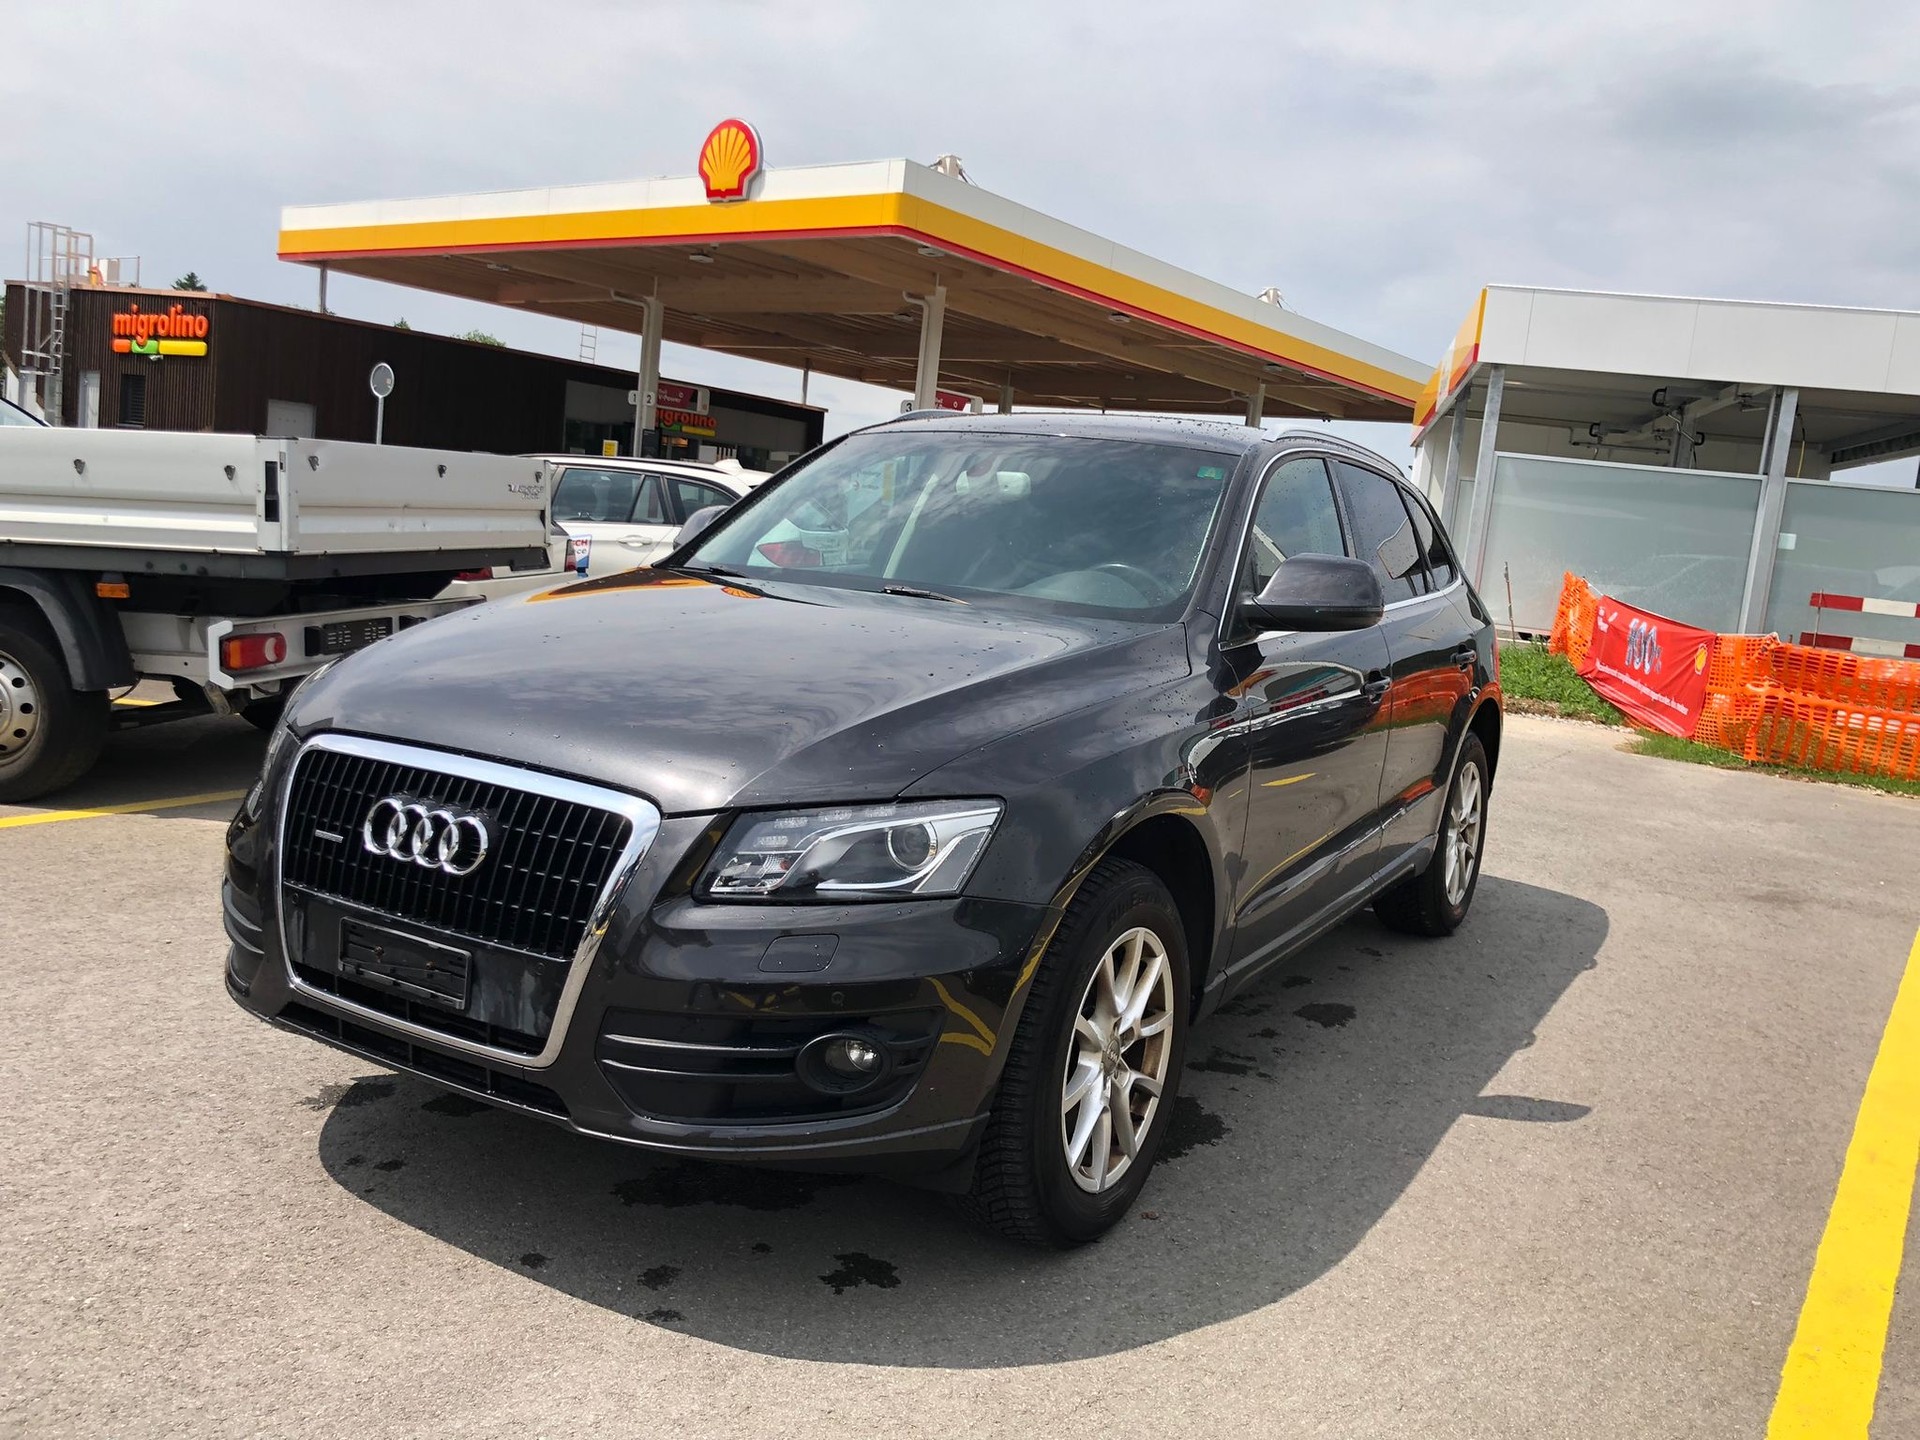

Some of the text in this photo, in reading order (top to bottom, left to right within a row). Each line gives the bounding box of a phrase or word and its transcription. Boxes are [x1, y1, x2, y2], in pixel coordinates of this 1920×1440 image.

[113, 304, 209, 346] migrolino
[646, 394, 652, 404] 2
[905, 402, 912, 412] 3
